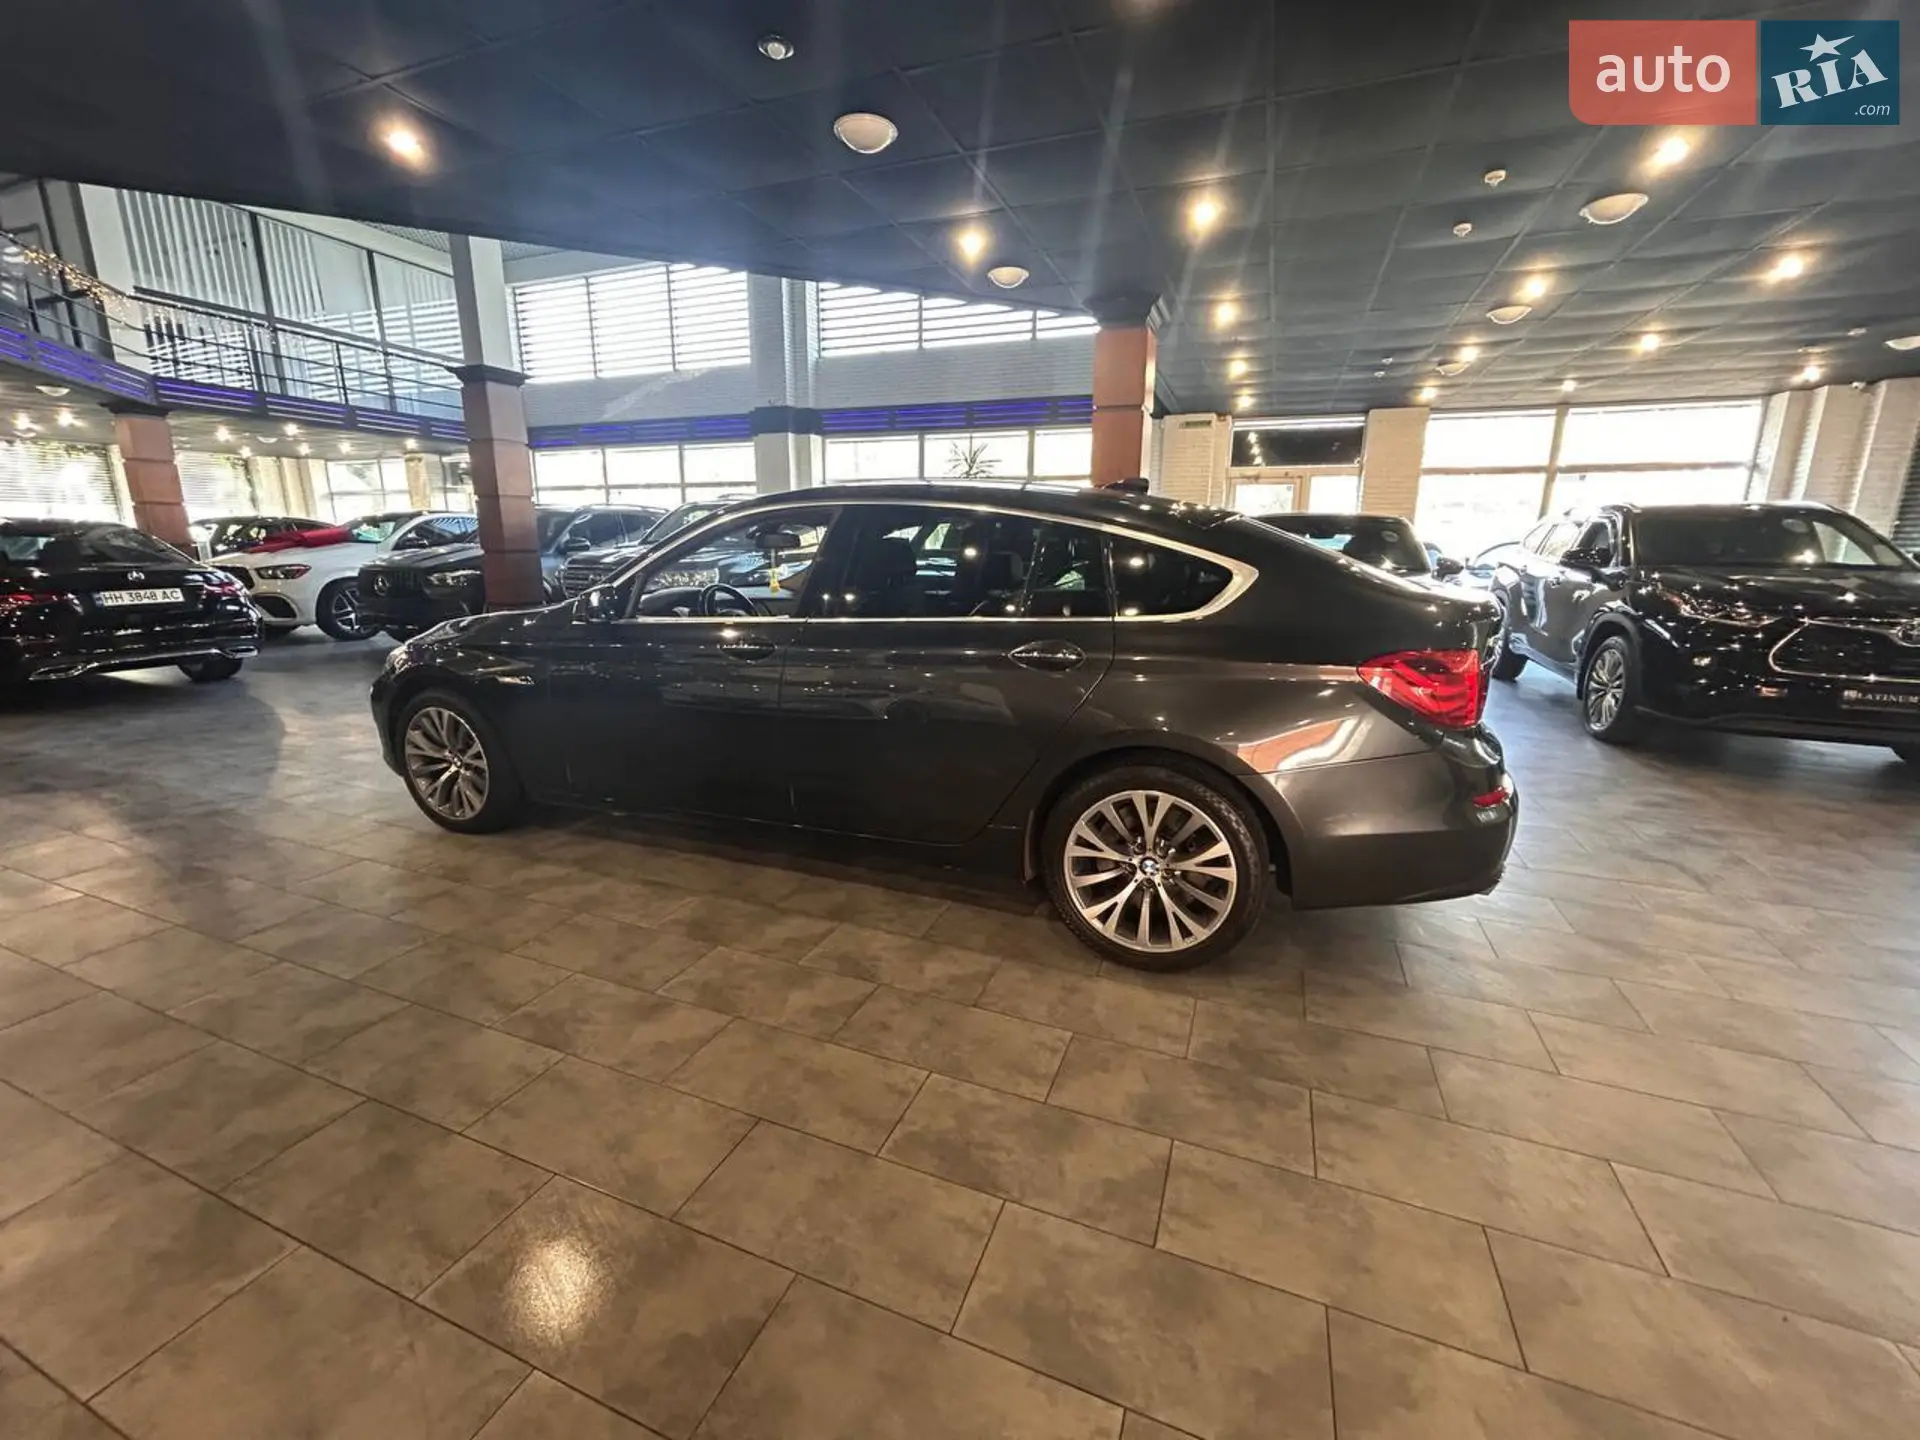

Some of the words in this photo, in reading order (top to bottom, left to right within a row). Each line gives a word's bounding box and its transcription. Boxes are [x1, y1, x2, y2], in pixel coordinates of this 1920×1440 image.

[103, 593, 125, 604] HH
[126, 591, 158, 602] 3848
[162, 590, 181, 601] AC
